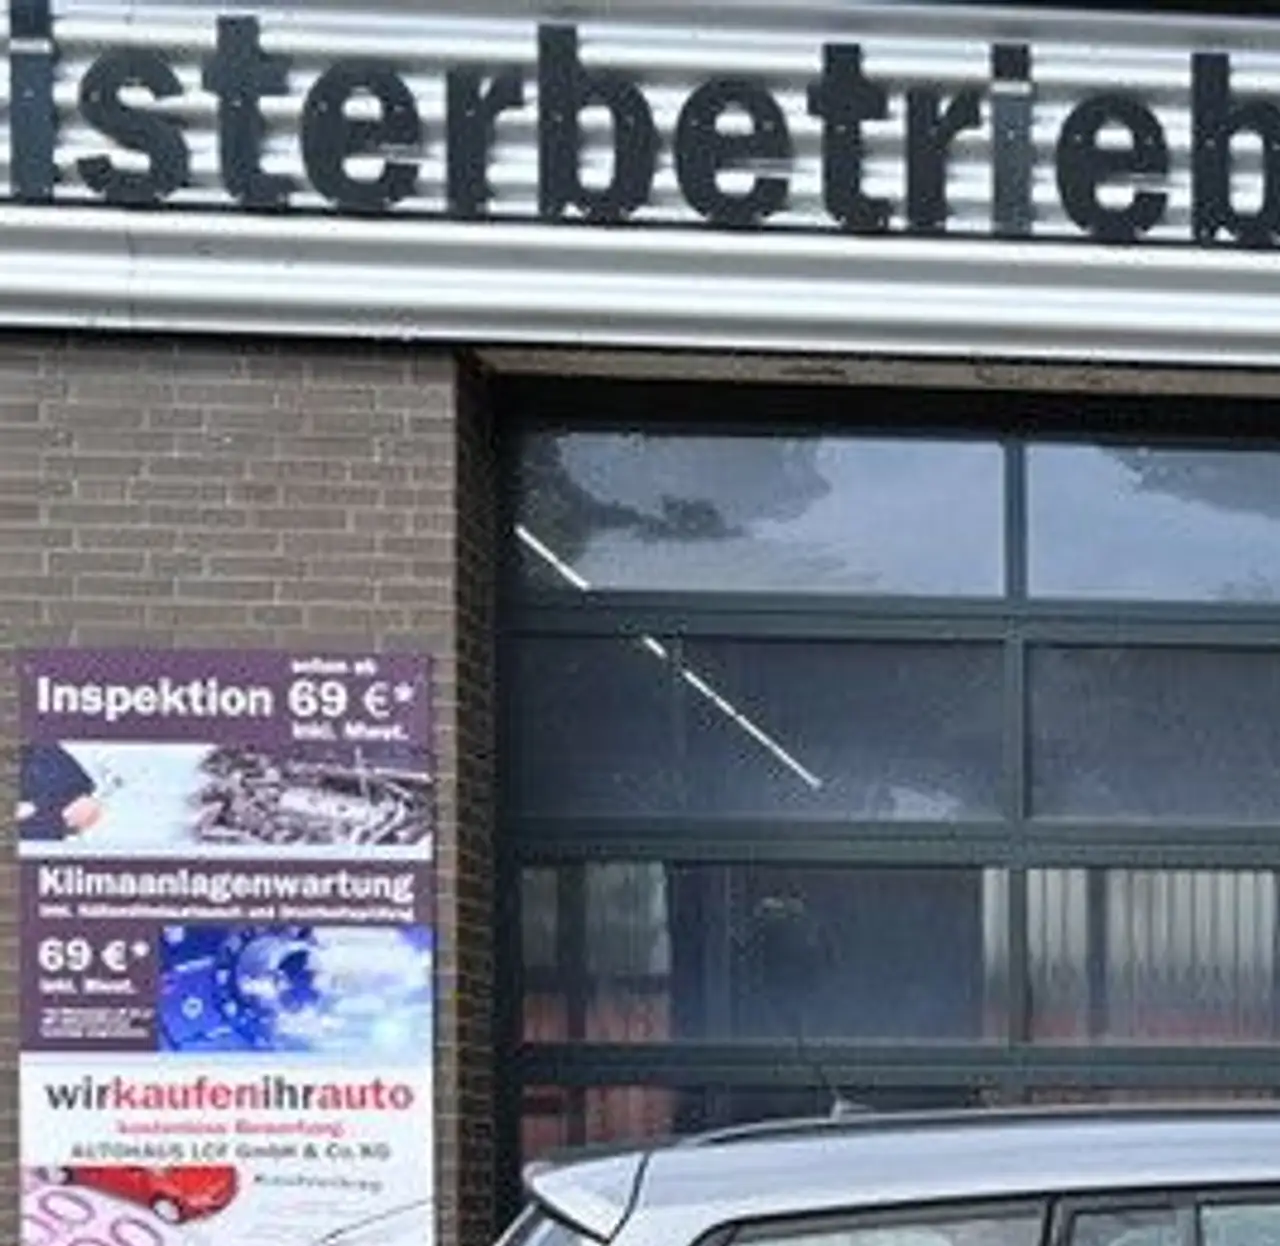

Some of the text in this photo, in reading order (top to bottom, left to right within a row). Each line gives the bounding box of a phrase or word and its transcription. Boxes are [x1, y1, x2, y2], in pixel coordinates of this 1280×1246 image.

[37, 677, 274, 722] Inspektion
[288, 680, 348, 718] 69
[38, 867, 414, 902] Klimaanlagenwartung
[38, 937, 92, 972] 69
[45, 1075, 415, 1111] wirkaufenihrauto
